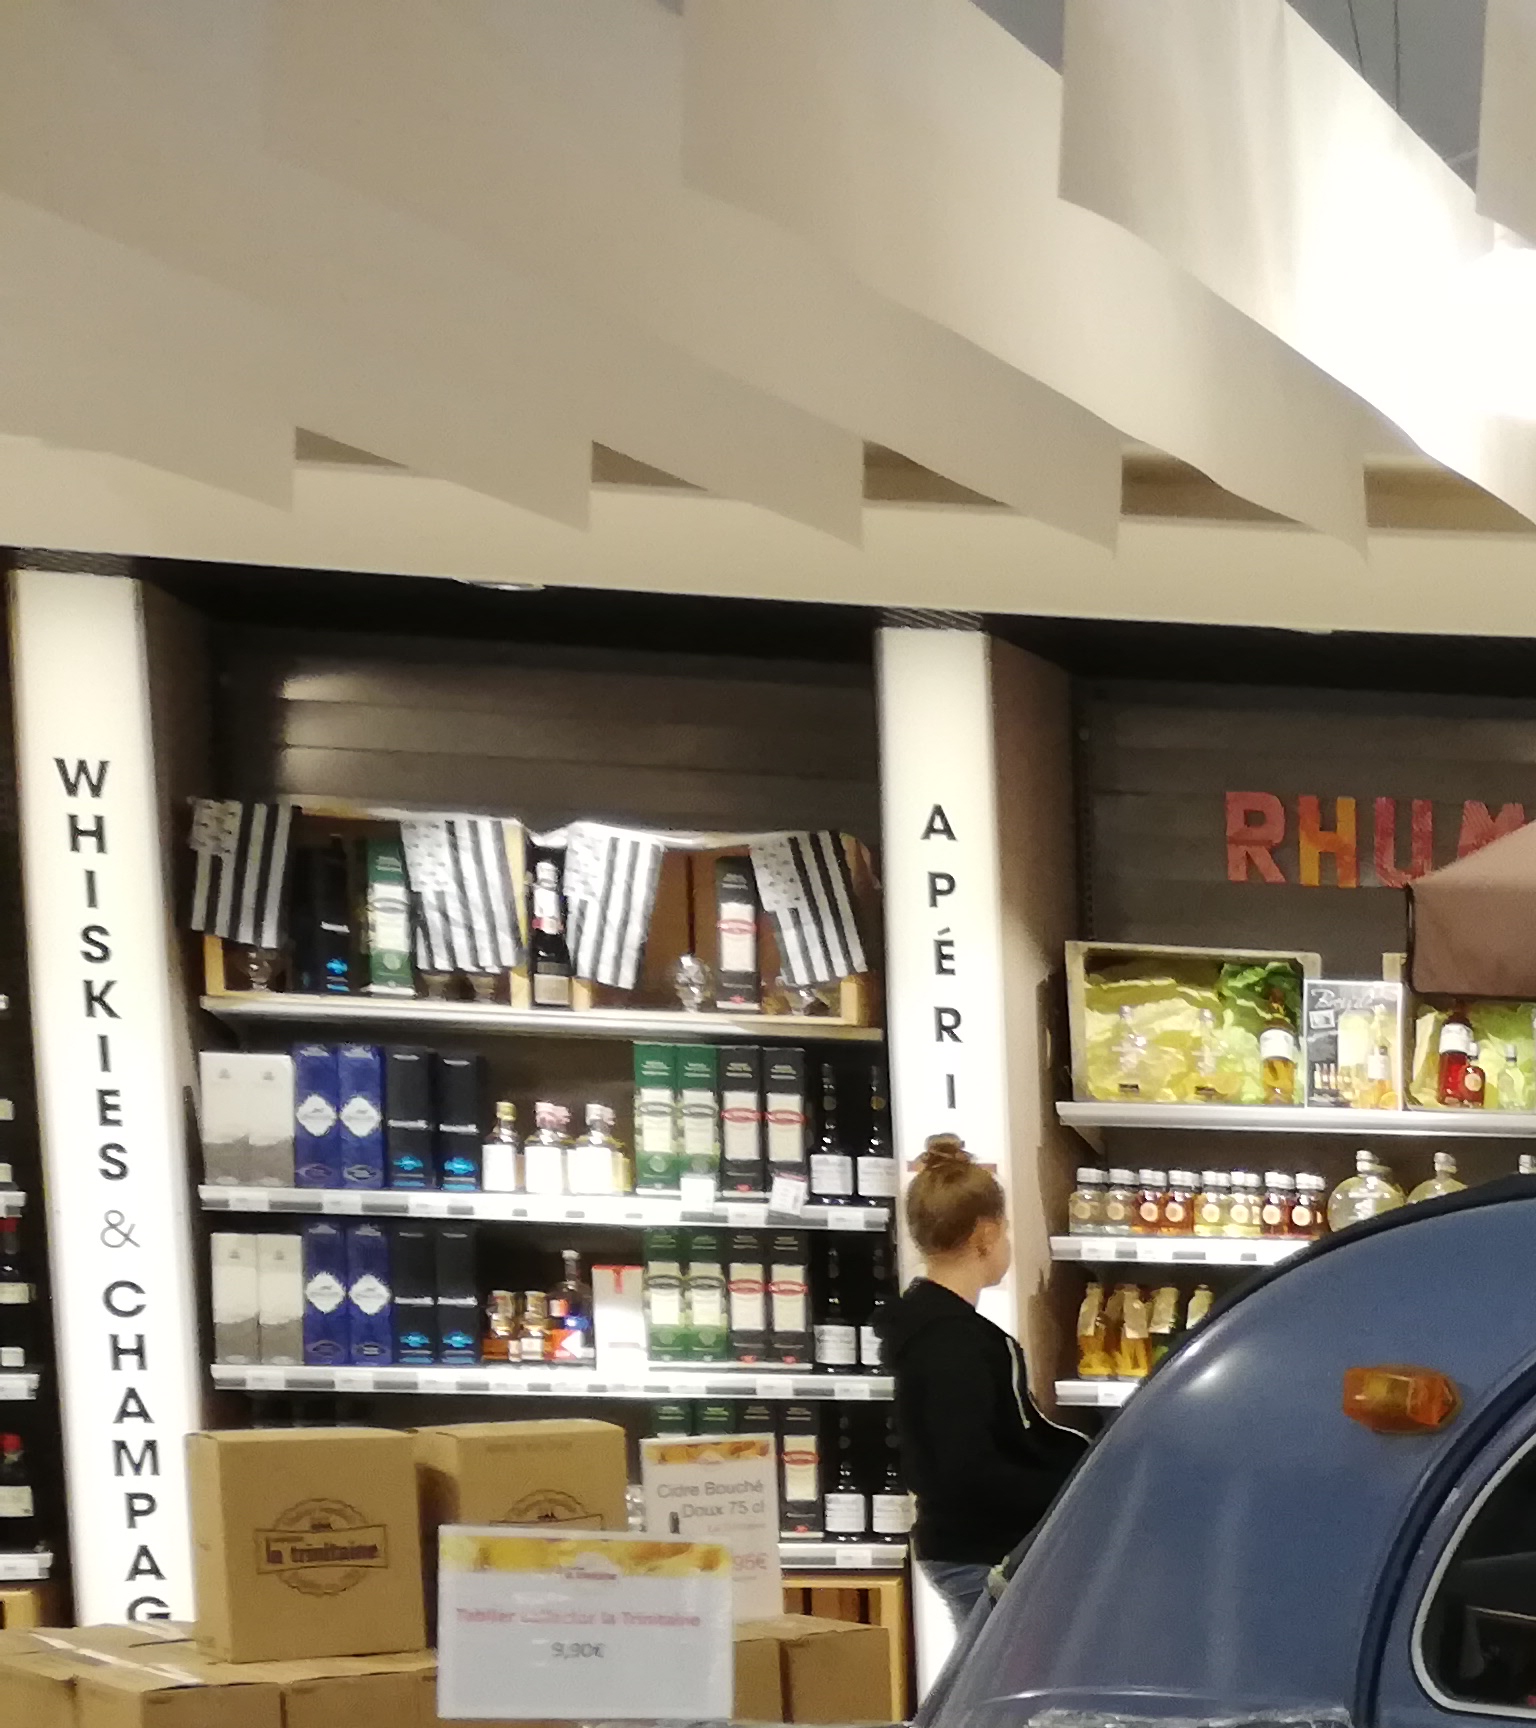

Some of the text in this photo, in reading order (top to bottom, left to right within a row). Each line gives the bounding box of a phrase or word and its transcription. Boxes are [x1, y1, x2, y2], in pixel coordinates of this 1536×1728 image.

[53, 757, 129, 1181] WHISKIES
[99, 1209, 141, 1249] &
[656, 1478, 764, 1499] Cidre Bouché
[681, 1503, 724, 1518] Doux
[728, 1501, 749, 1515] 75
